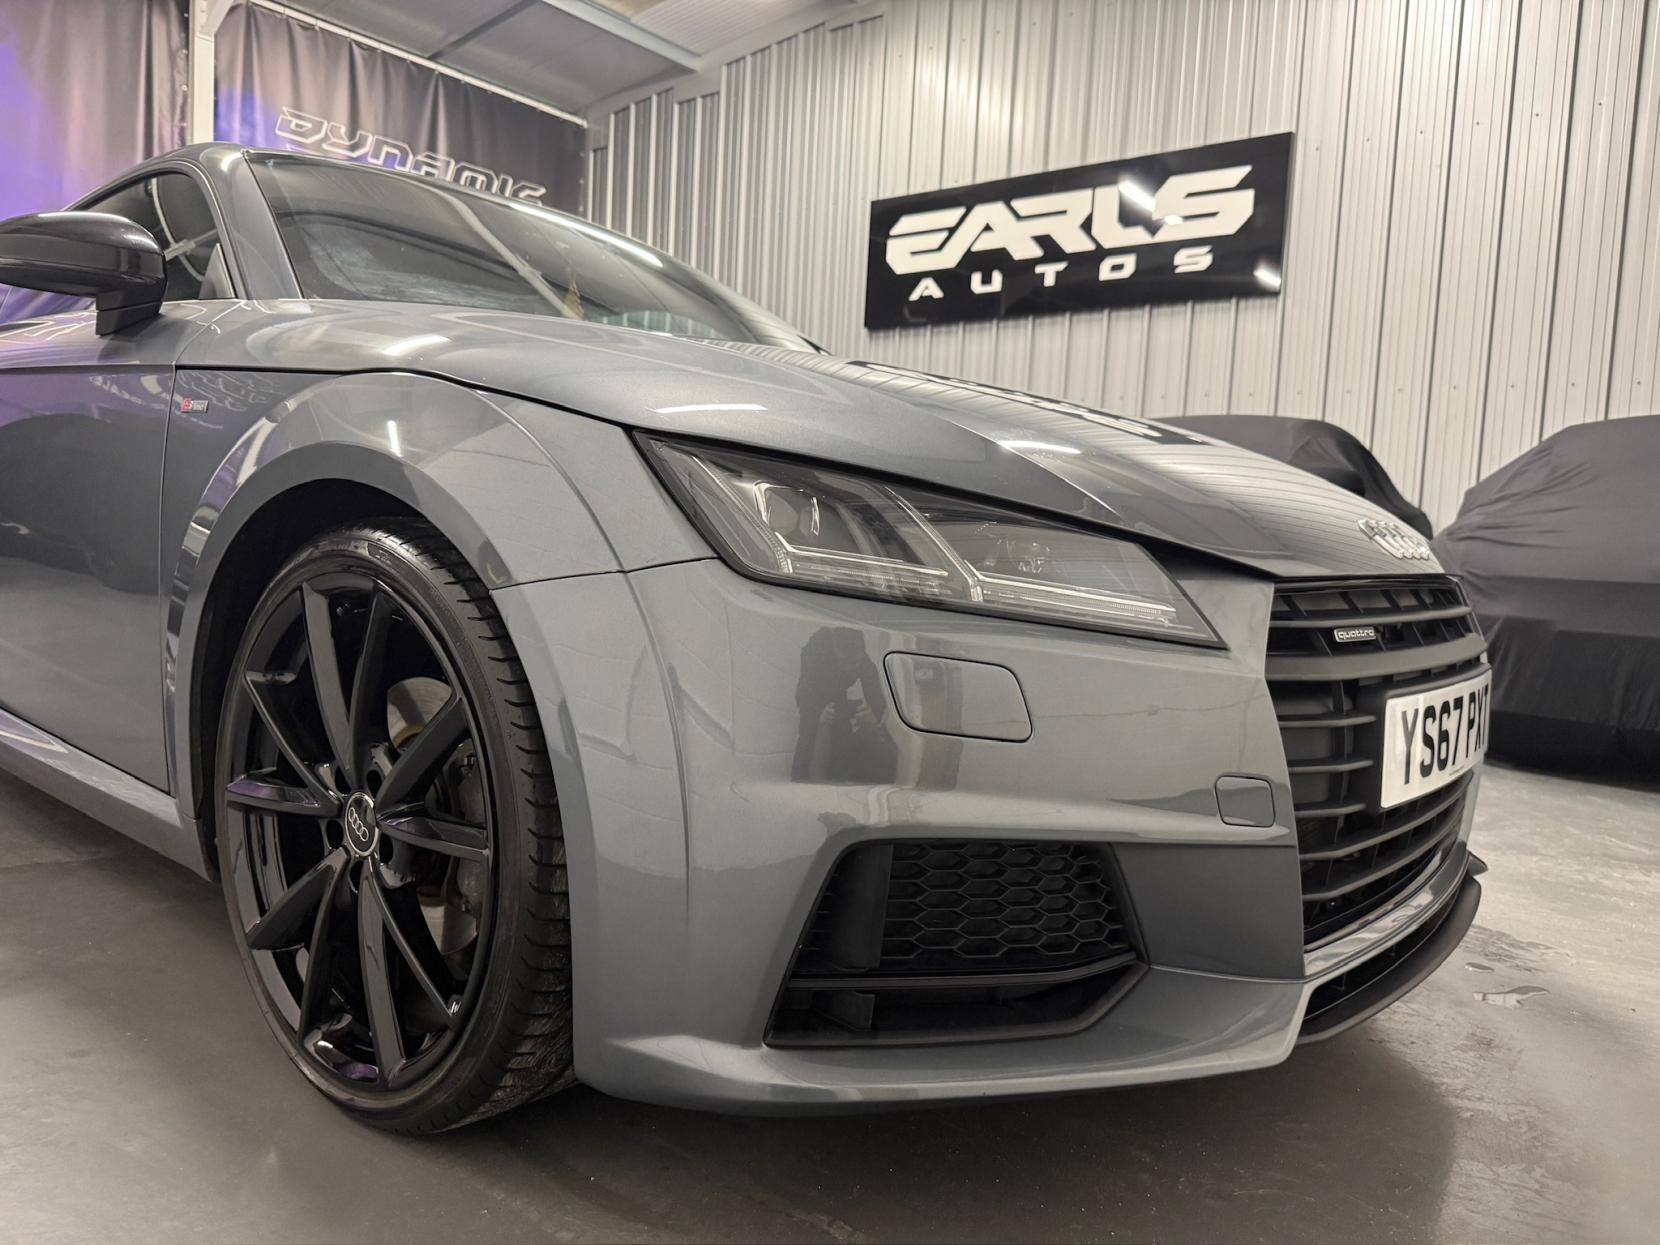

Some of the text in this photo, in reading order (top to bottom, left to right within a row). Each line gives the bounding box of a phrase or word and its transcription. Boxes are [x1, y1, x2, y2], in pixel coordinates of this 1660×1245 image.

[886, 165, 1255, 275] EARLS
[909, 245, 1213, 301] AUTOS
[1337, 629, 1375, 640] quattro
[1401, 684, 1489, 785] YS67 PXT
